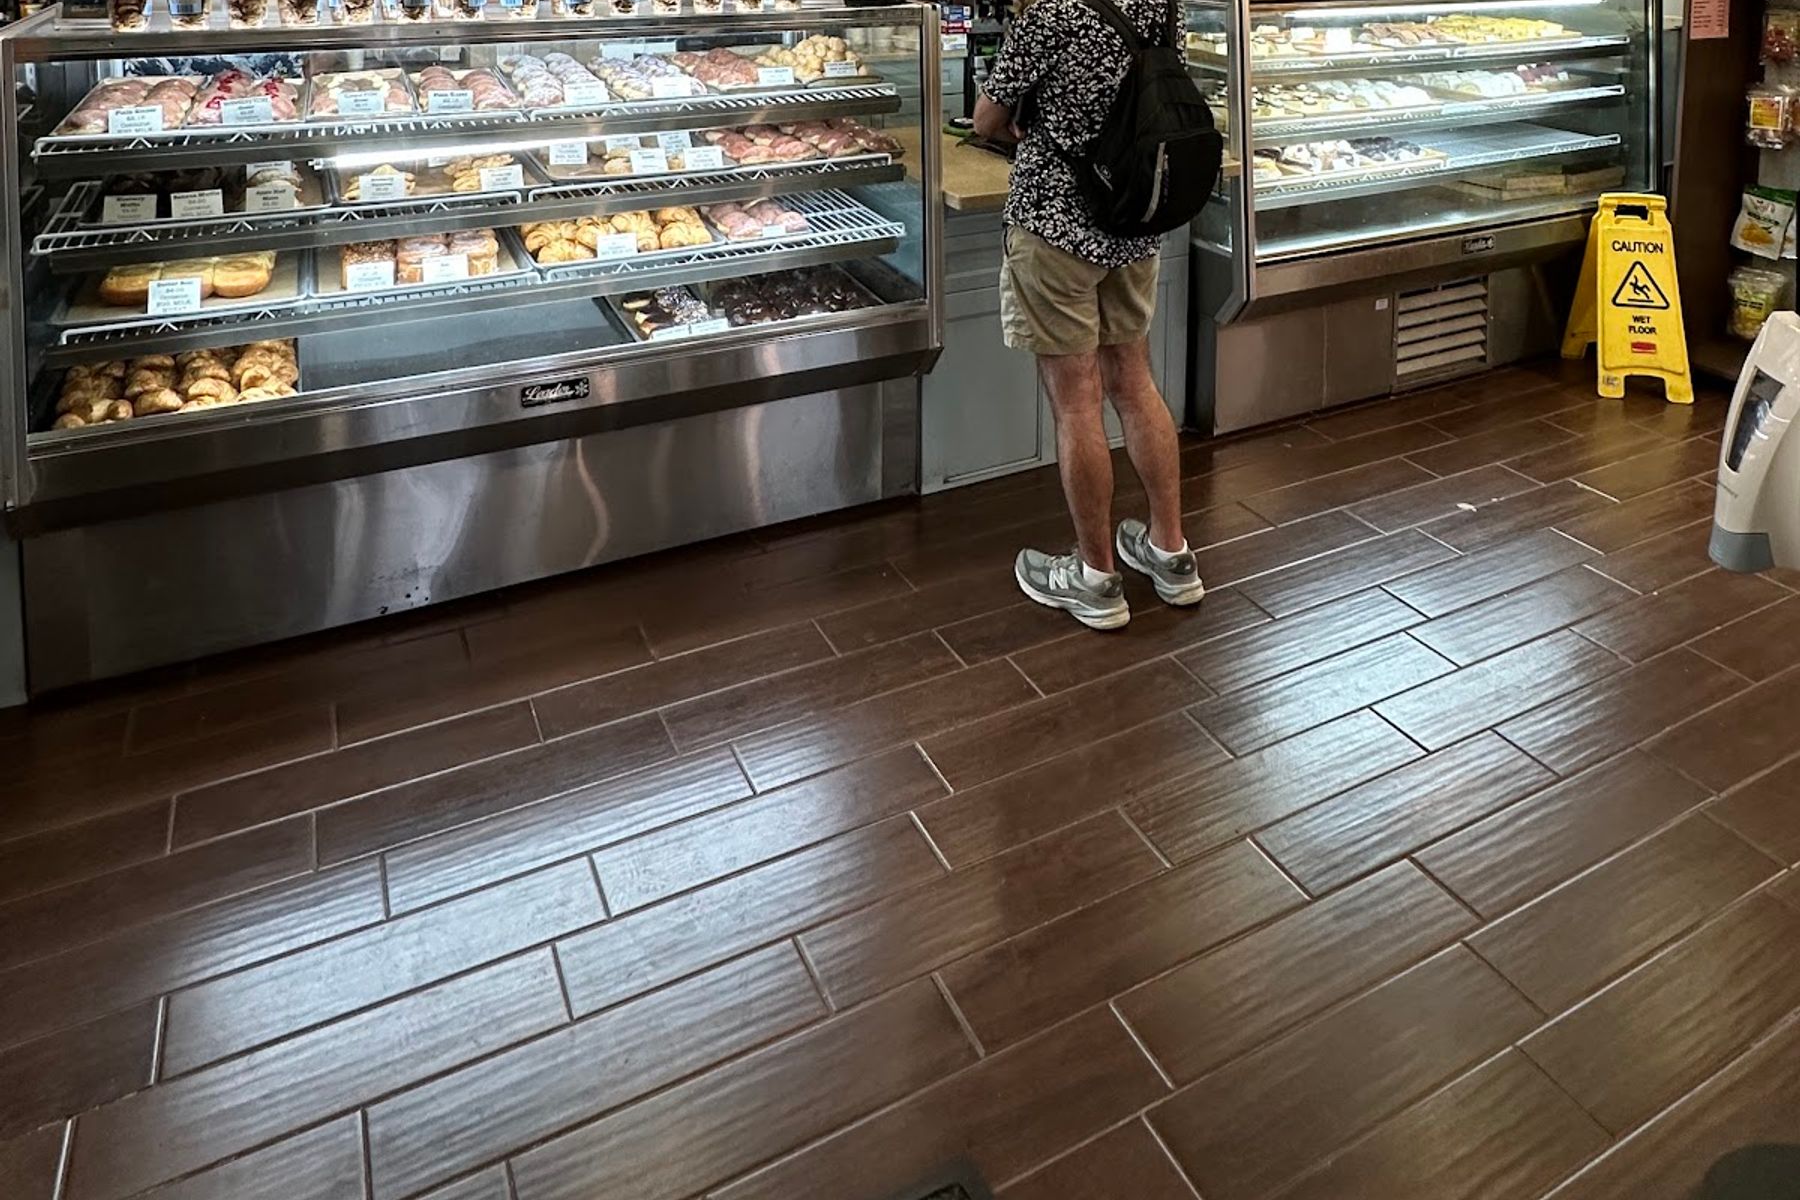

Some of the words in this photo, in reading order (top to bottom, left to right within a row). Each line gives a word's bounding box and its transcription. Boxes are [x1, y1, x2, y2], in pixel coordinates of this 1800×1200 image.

[1612, 240, 1664, 254] CAUTION
[1632, 315, 1651, 324] WET
[1628, 325, 1657, 335] FLOOR
[1049, 568, 1070, 591] N
